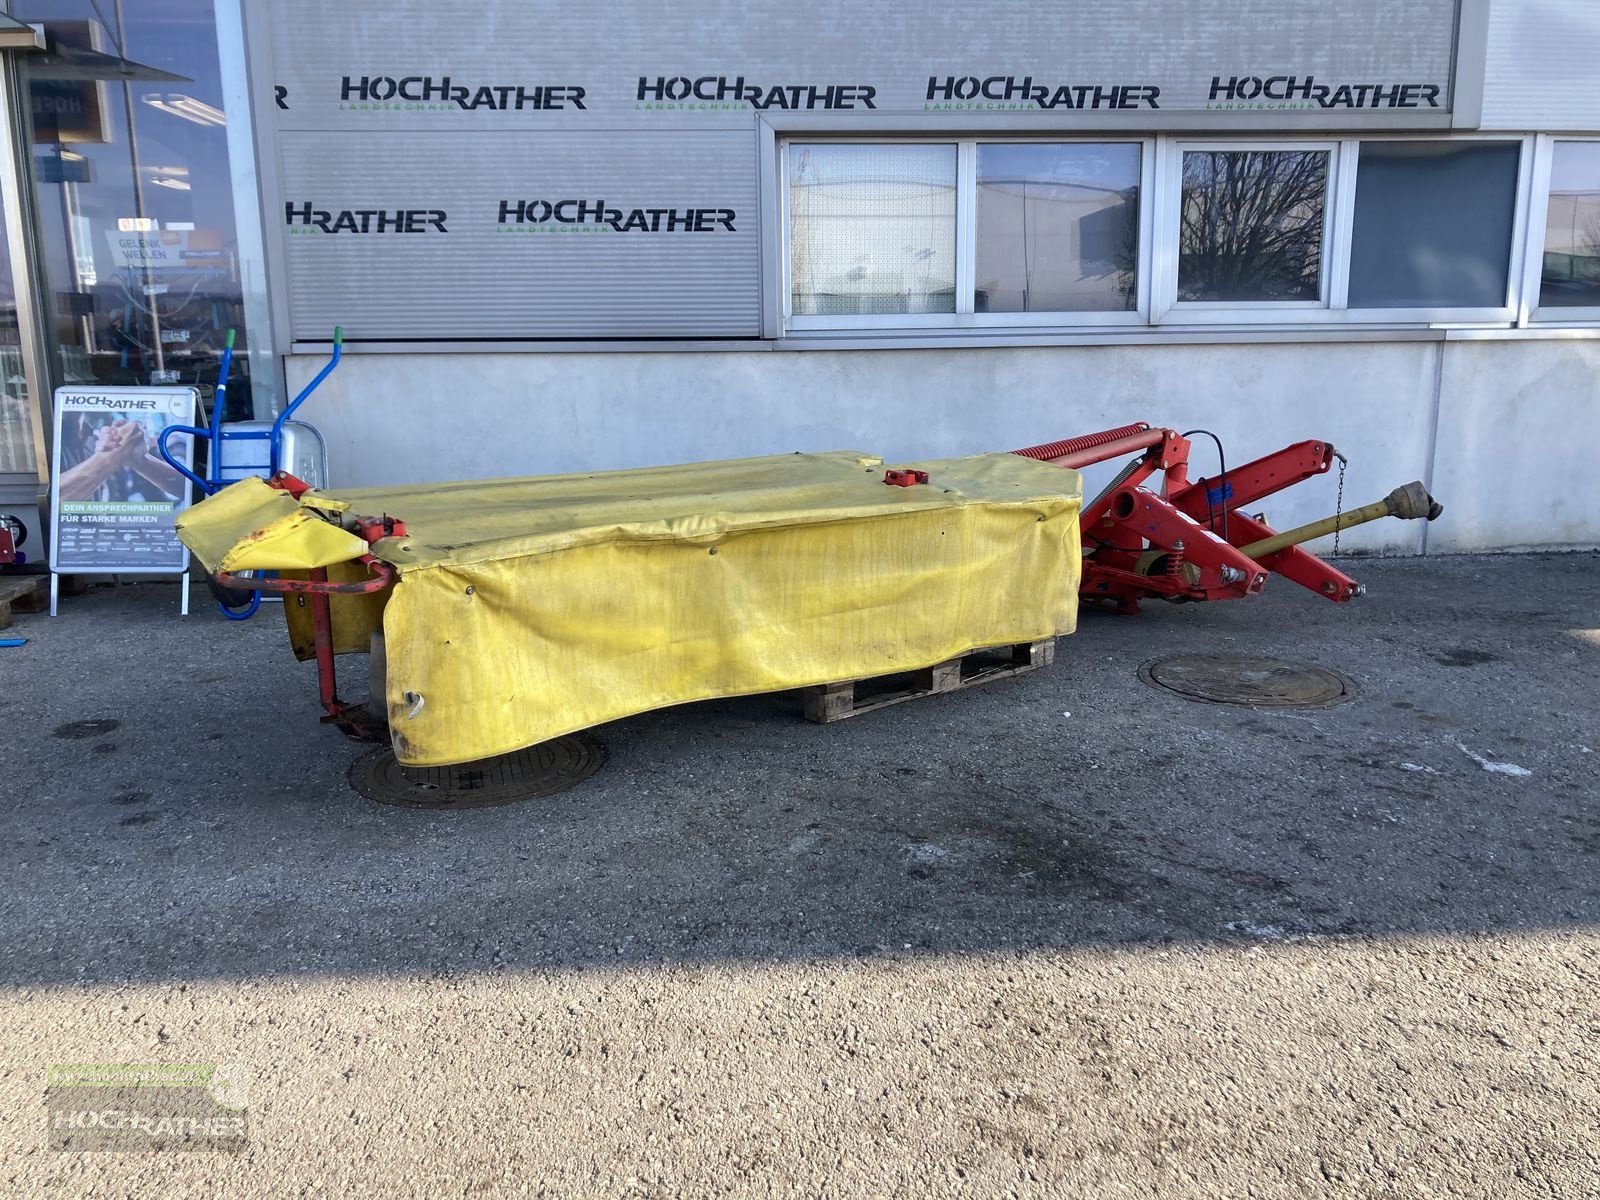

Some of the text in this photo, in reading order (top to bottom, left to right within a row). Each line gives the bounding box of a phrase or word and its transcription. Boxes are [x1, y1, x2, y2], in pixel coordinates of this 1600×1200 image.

[341, 76, 587, 110] HOCHRATHER
[637, 76, 877, 110] HOCHRATHER
[926, 76, 1160, 109] HOCHRATHER
[1208, 75, 1440, 108] HOCHRATHER
[339, 103, 454, 111] LANDTECHNIK
[635, 103, 748, 111] LANDTECHNIK
[1206, 102, 1315, 110] LANDTECHNIK
[498, 199, 737, 232] HOCHRATHER
[496, 225, 609, 233] LANDTECHNIK
[119, 239, 161, 248] GELENK
[122, 250, 167, 259] WELLEN
[65, 395, 157, 409] HOCHRATHER
[63, 503, 171, 512] DEIN ANSPRECHPARTNER
[60, 514, 158, 523] FÜR STARKE MARKEN
